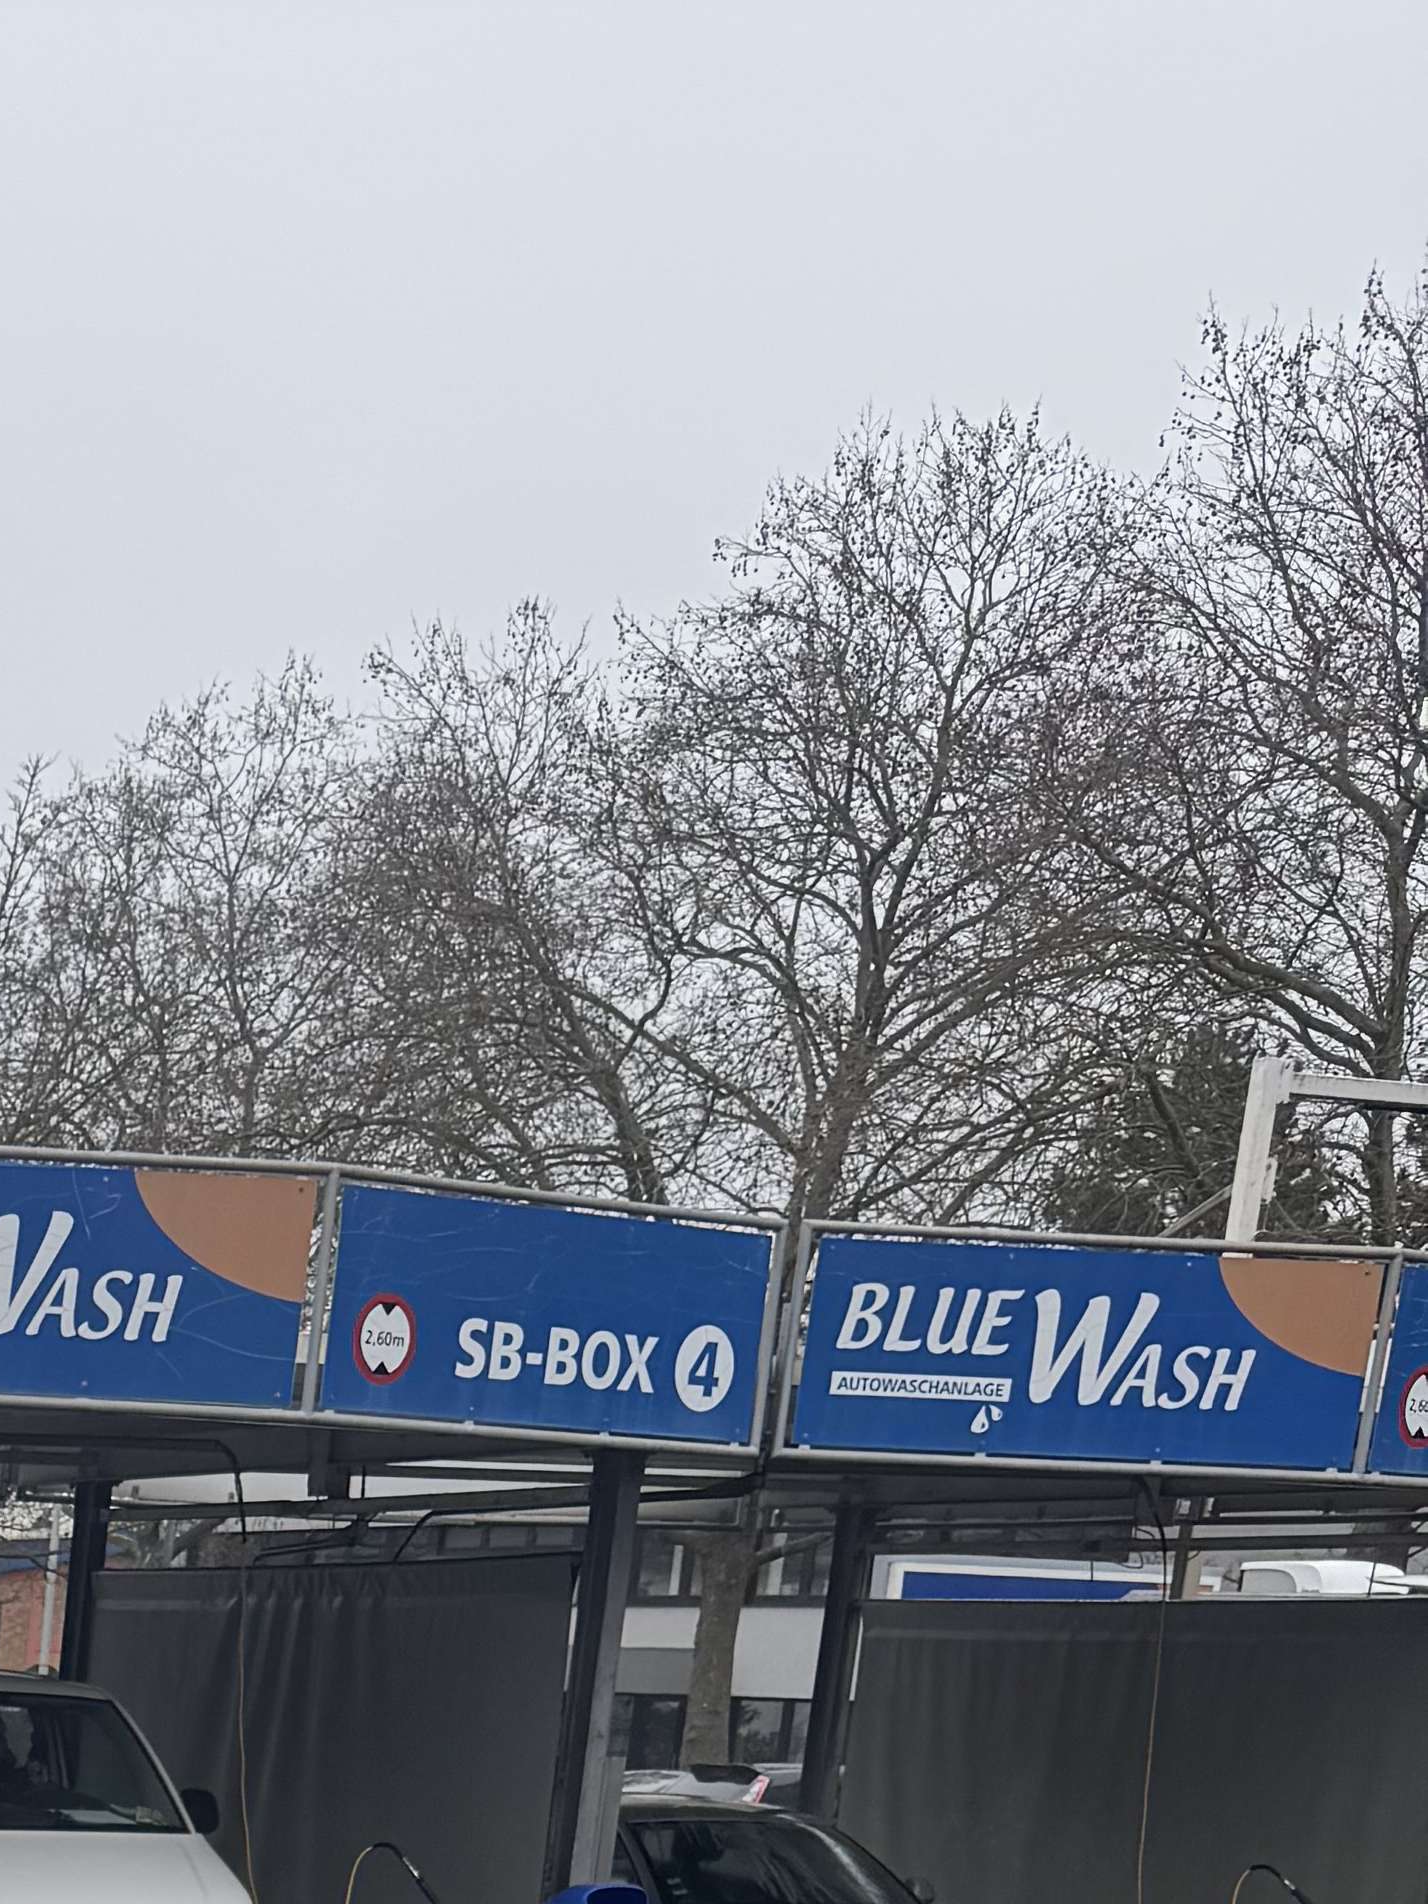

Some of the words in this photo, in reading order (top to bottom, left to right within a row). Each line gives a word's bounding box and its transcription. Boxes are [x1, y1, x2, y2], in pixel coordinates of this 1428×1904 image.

[364, 1329, 405, 1348] 2,60m
[454, 1317, 660, 1394] SB-BOX
[687, 1339, 720, 1398] 4
[836, 1282, 1025, 1356] BLUE
[1029, 1288, 1257, 1411] WASH
[836, 1376, 1008, 1401] AUTOWASCHANLAGE
